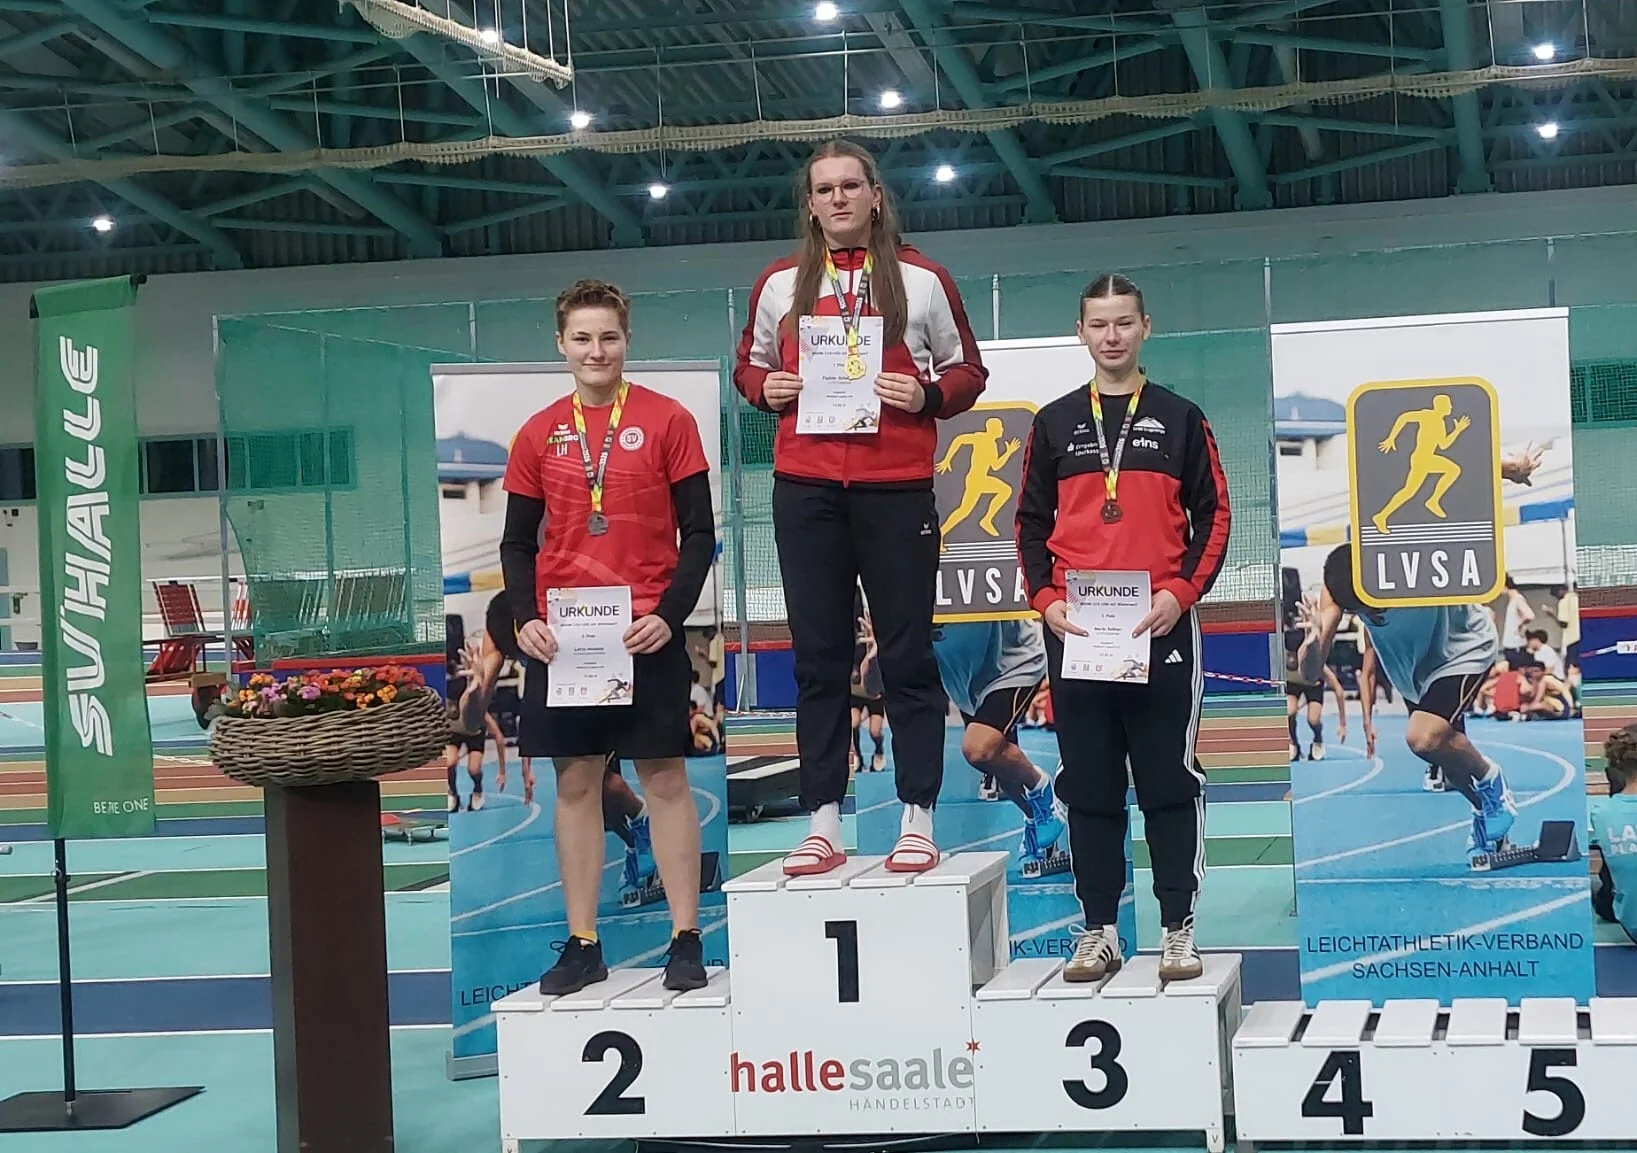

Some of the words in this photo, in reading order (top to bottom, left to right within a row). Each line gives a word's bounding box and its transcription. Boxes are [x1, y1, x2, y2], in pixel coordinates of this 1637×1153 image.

[811, 334, 871, 346] URKUDE
[556, 443, 568, 457] LH
[1132, 436, 1159, 450] eins
[1377, 549, 1481, 590] LVSA
[1078, 585, 1140, 598] URKUNDE
[560, 605, 620, 618] URKUNDE
[93, 801, 107, 814] BE
[122, 798, 149, 813] ONE
[1307, 933, 1584, 953] LEICHTATHLETIK-VERBAND
[824, 920, 859, 1003] 1
[1352, 960, 1540, 979] SACHSEN-ANHALT
[581, 1030, 646, 1115] 2
[1062, 1019, 1129, 1110] 3
[1301, 1050, 1373, 1135] 4
[1521, 1048, 1586, 1137] 5
[850, 1096, 976, 1111] HÄNDELSTADT
